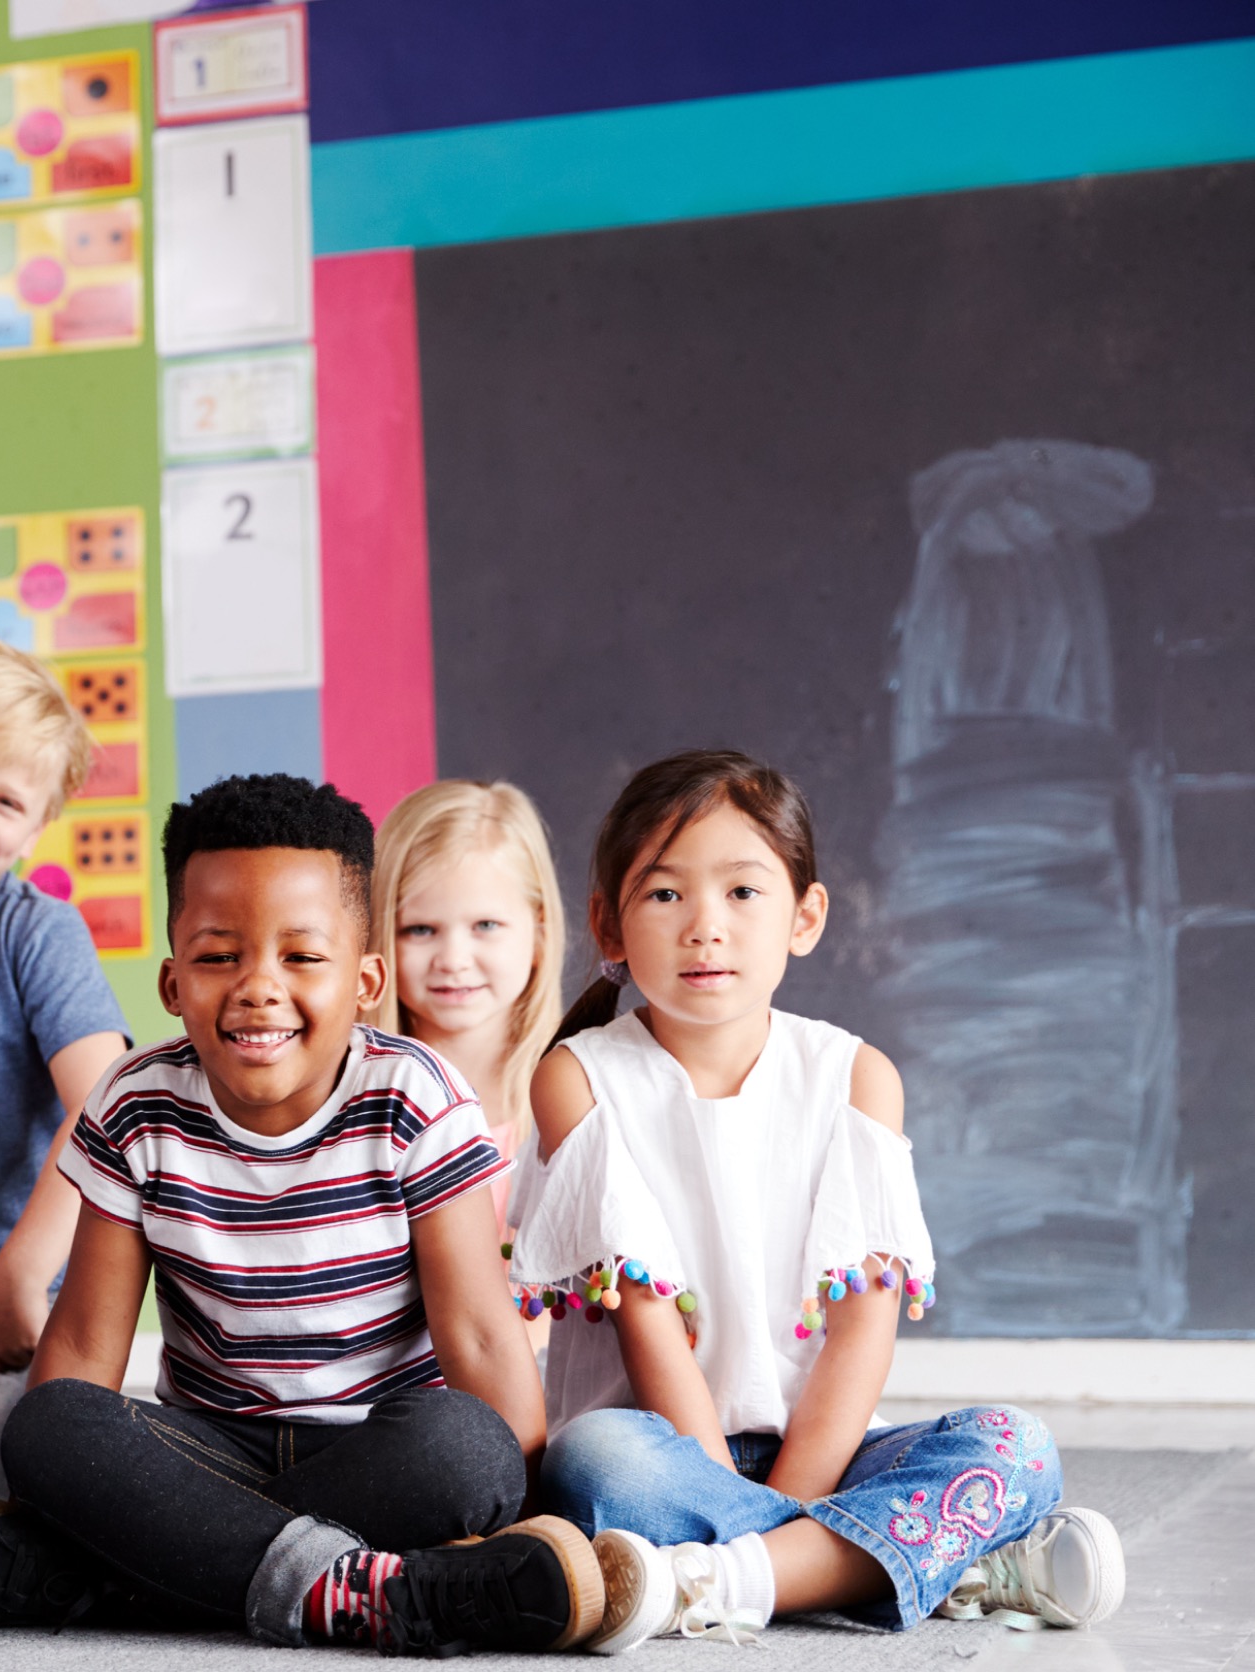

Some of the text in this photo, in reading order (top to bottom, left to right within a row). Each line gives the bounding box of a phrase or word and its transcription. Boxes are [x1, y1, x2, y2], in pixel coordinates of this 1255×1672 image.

[189, 55, 207, 89] 1
[223, 148, 235, 199] 1
[194, 395, 218, 432] 2
[223, 492, 256, 542] 2
